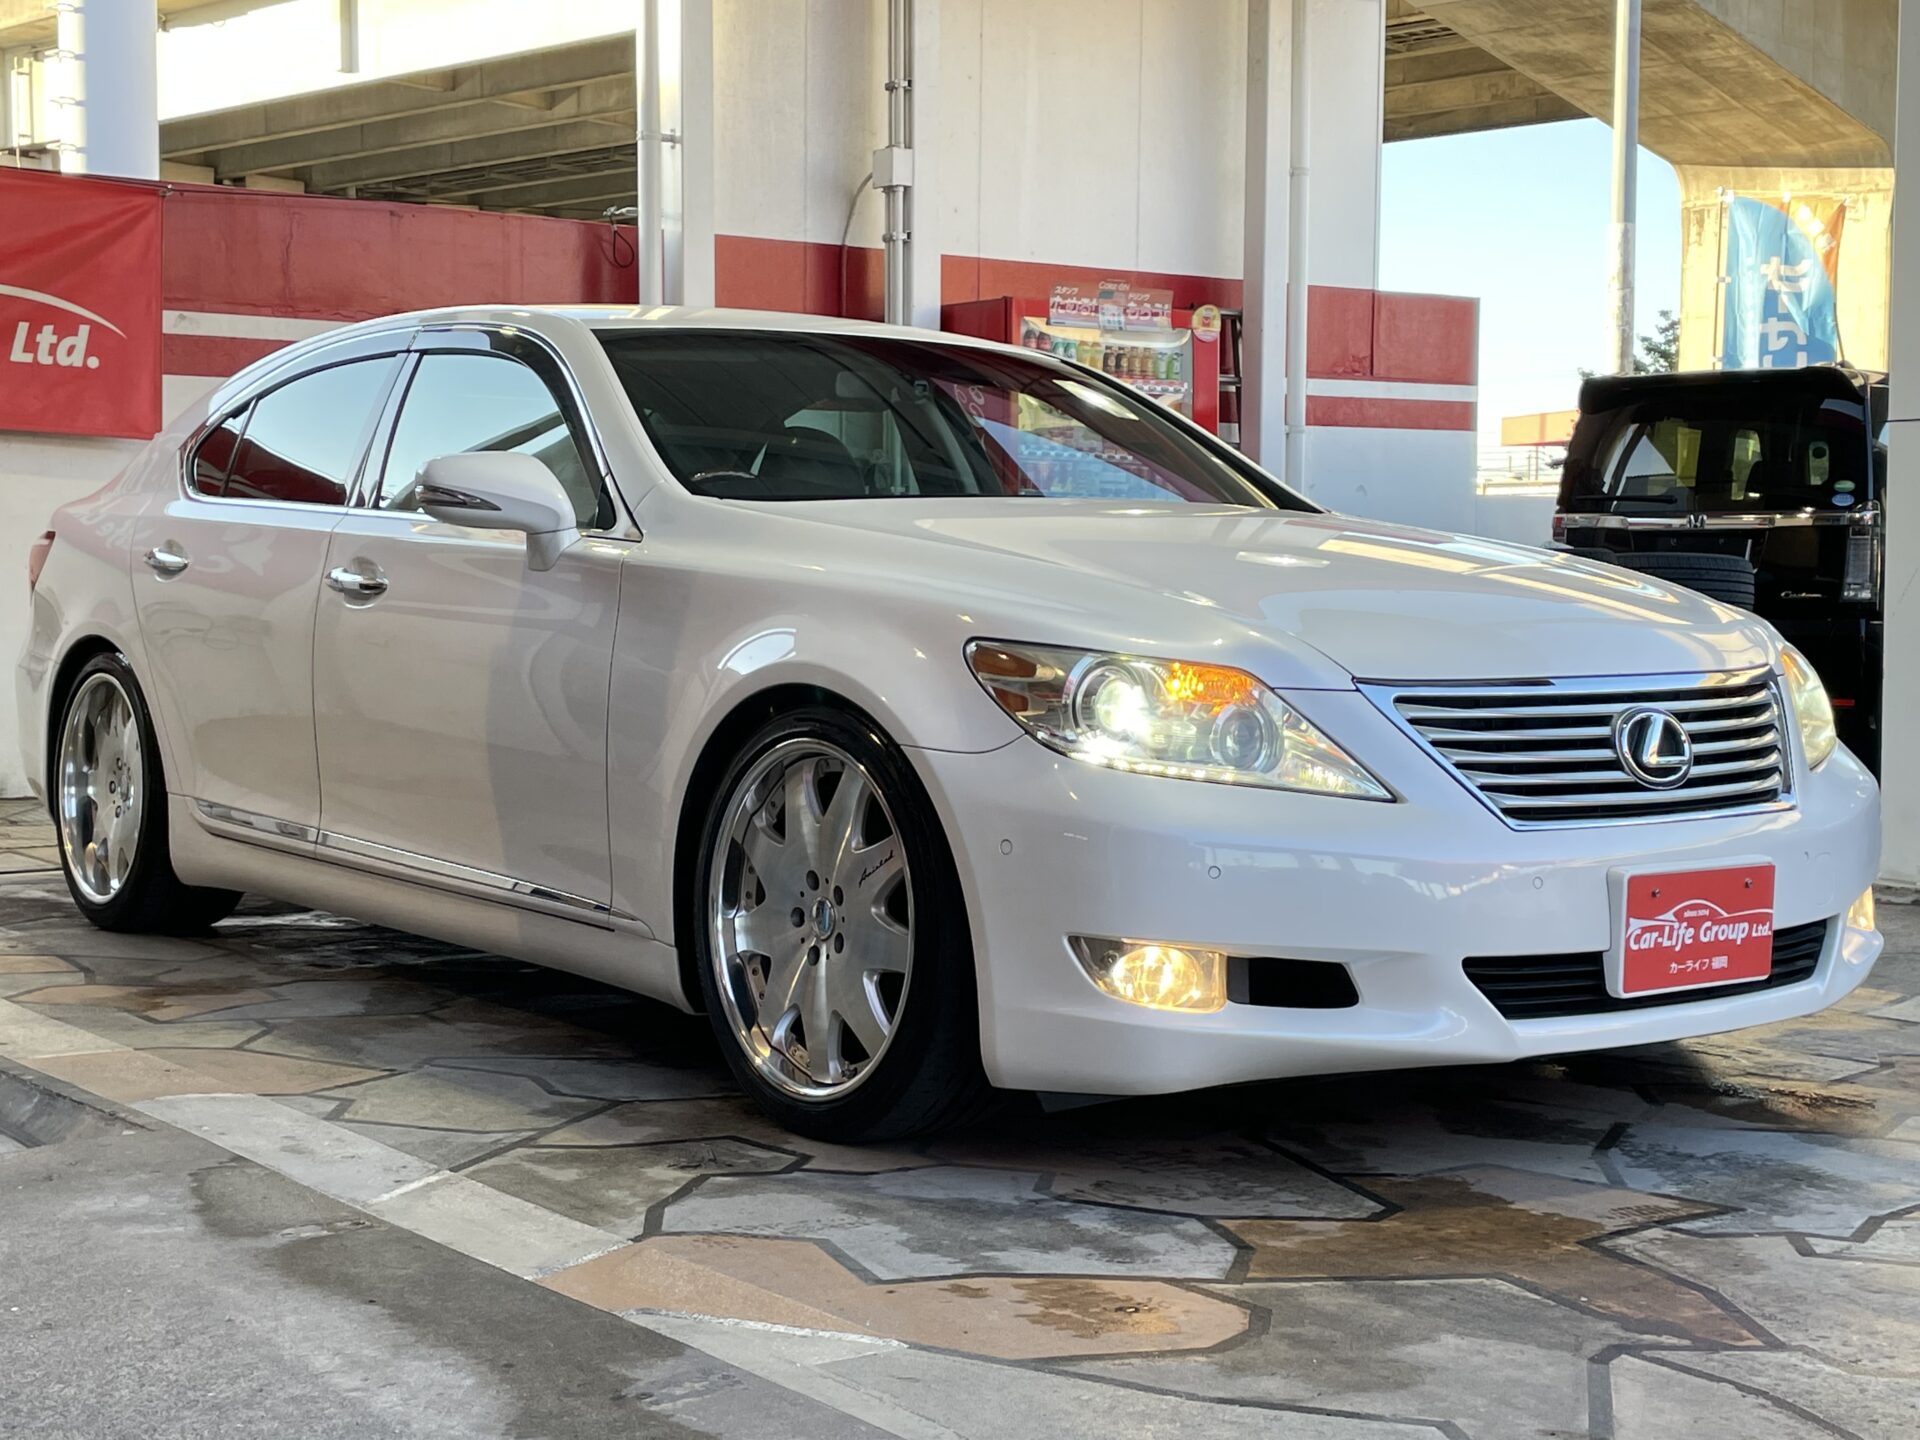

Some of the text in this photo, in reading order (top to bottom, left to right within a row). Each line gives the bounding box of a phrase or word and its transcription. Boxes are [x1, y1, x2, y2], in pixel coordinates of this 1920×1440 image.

[10, 321, 100, 370] Ltd.
[1629, 920, 1772, 952] Car-Life Group Ltd.
